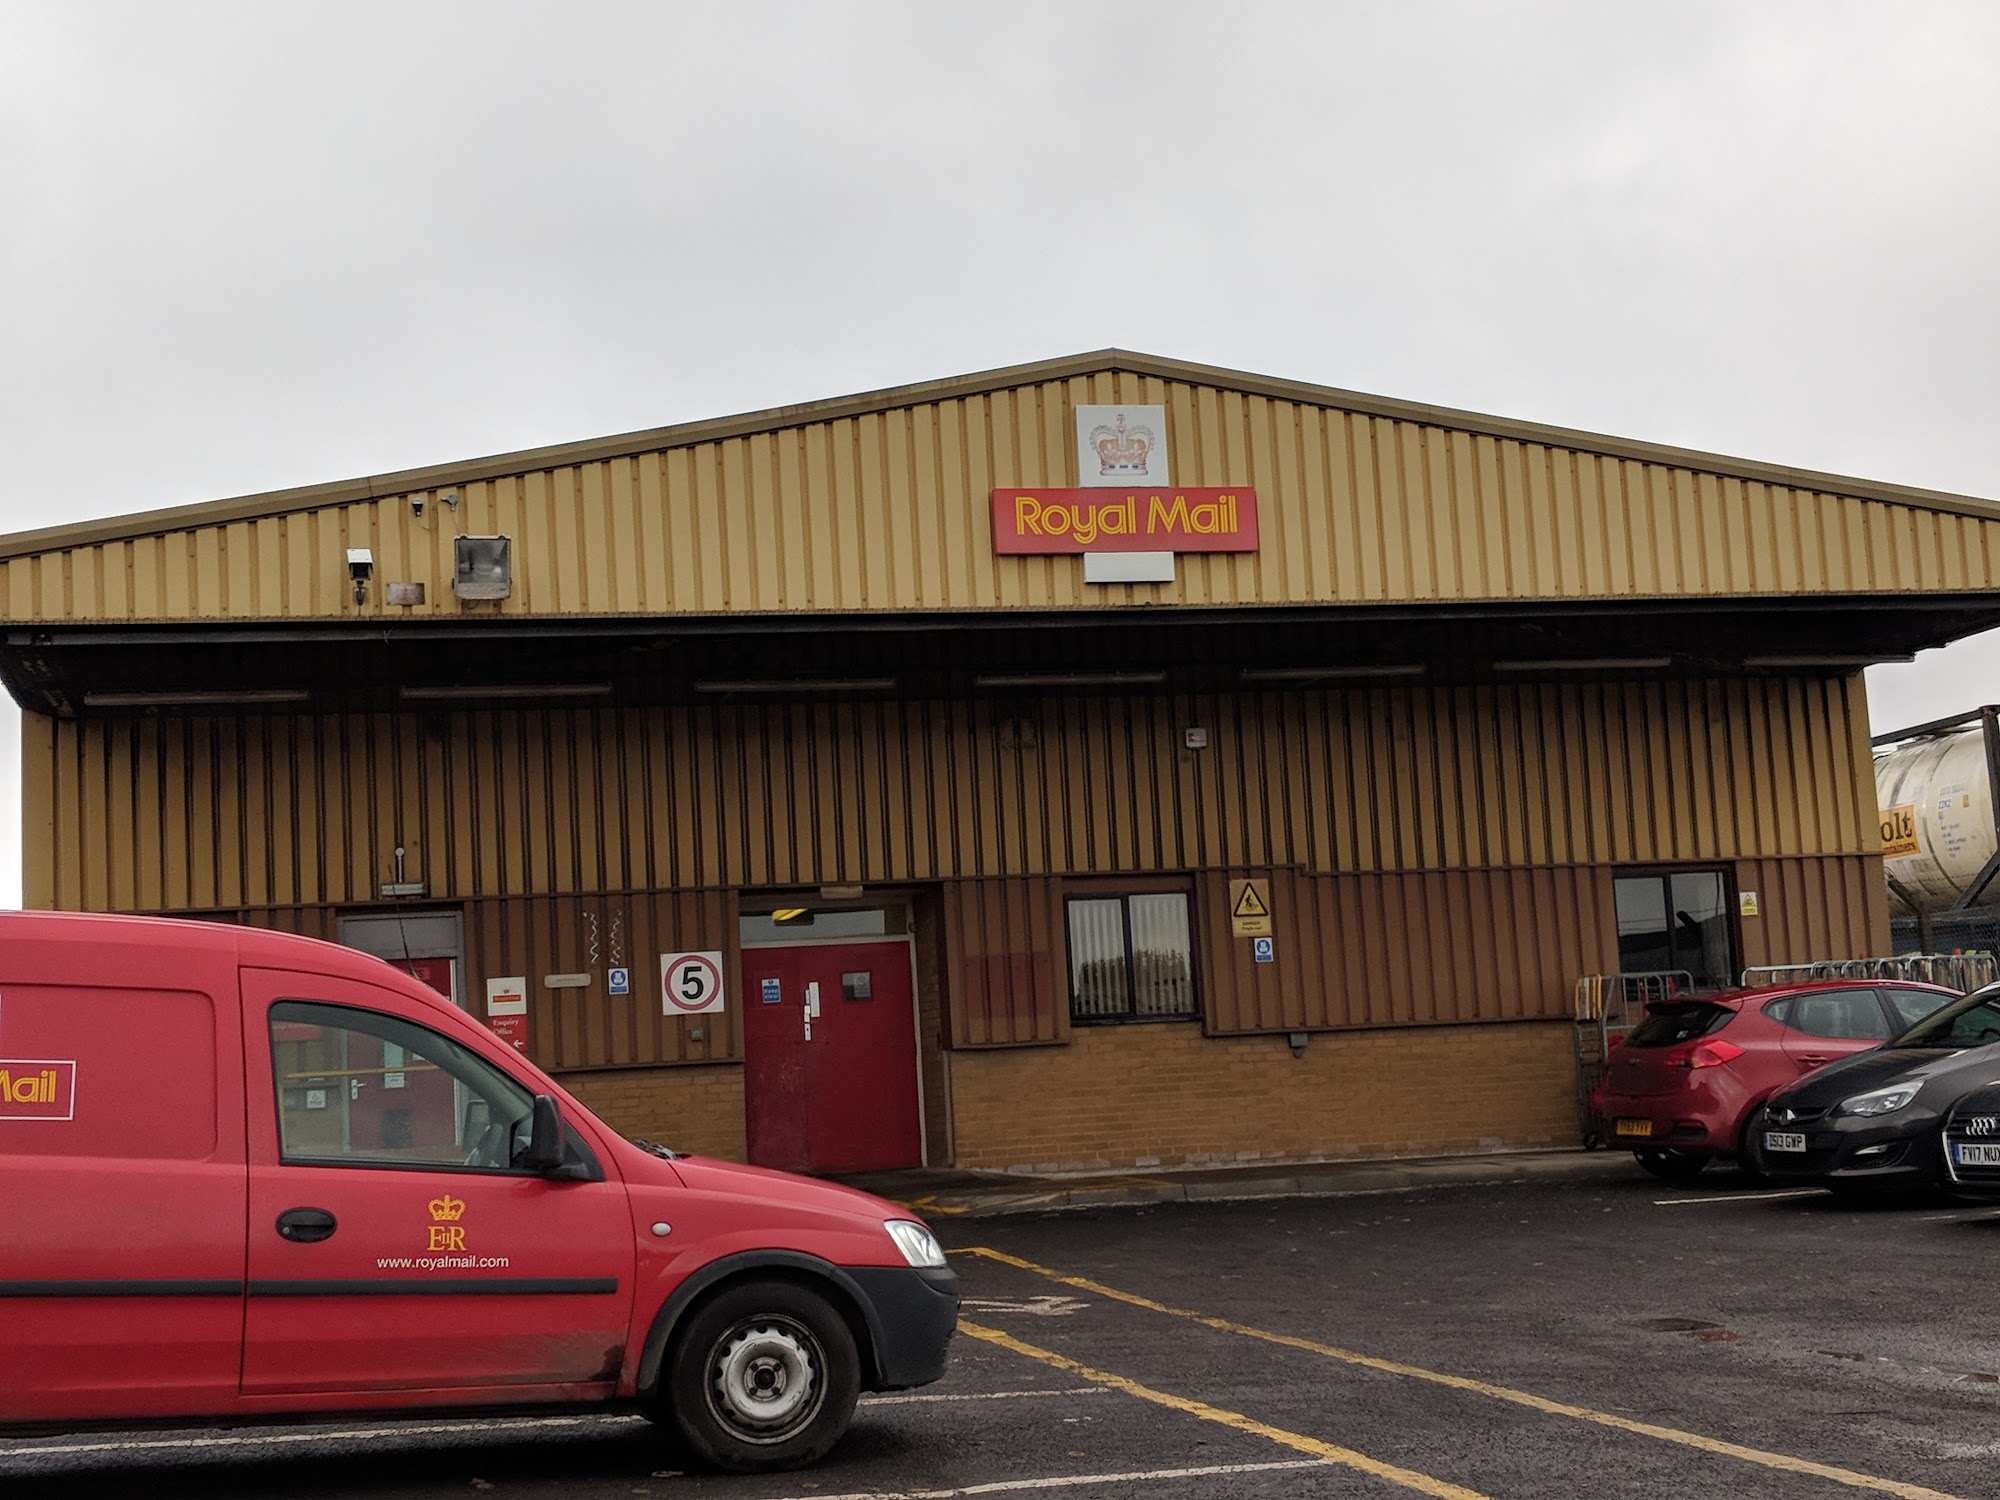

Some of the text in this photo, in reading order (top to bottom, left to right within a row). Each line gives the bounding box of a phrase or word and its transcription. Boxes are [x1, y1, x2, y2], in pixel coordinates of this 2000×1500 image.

[1015, 495, 1238, 544] Royal Mail
[681, 966, 704, 1000] 5
[493, 1018, 519, 1027] Enquiry
[1962, 1147, 1980, 1161] FV17
[377, 1255, 509, 1271] www.royalmail.com
